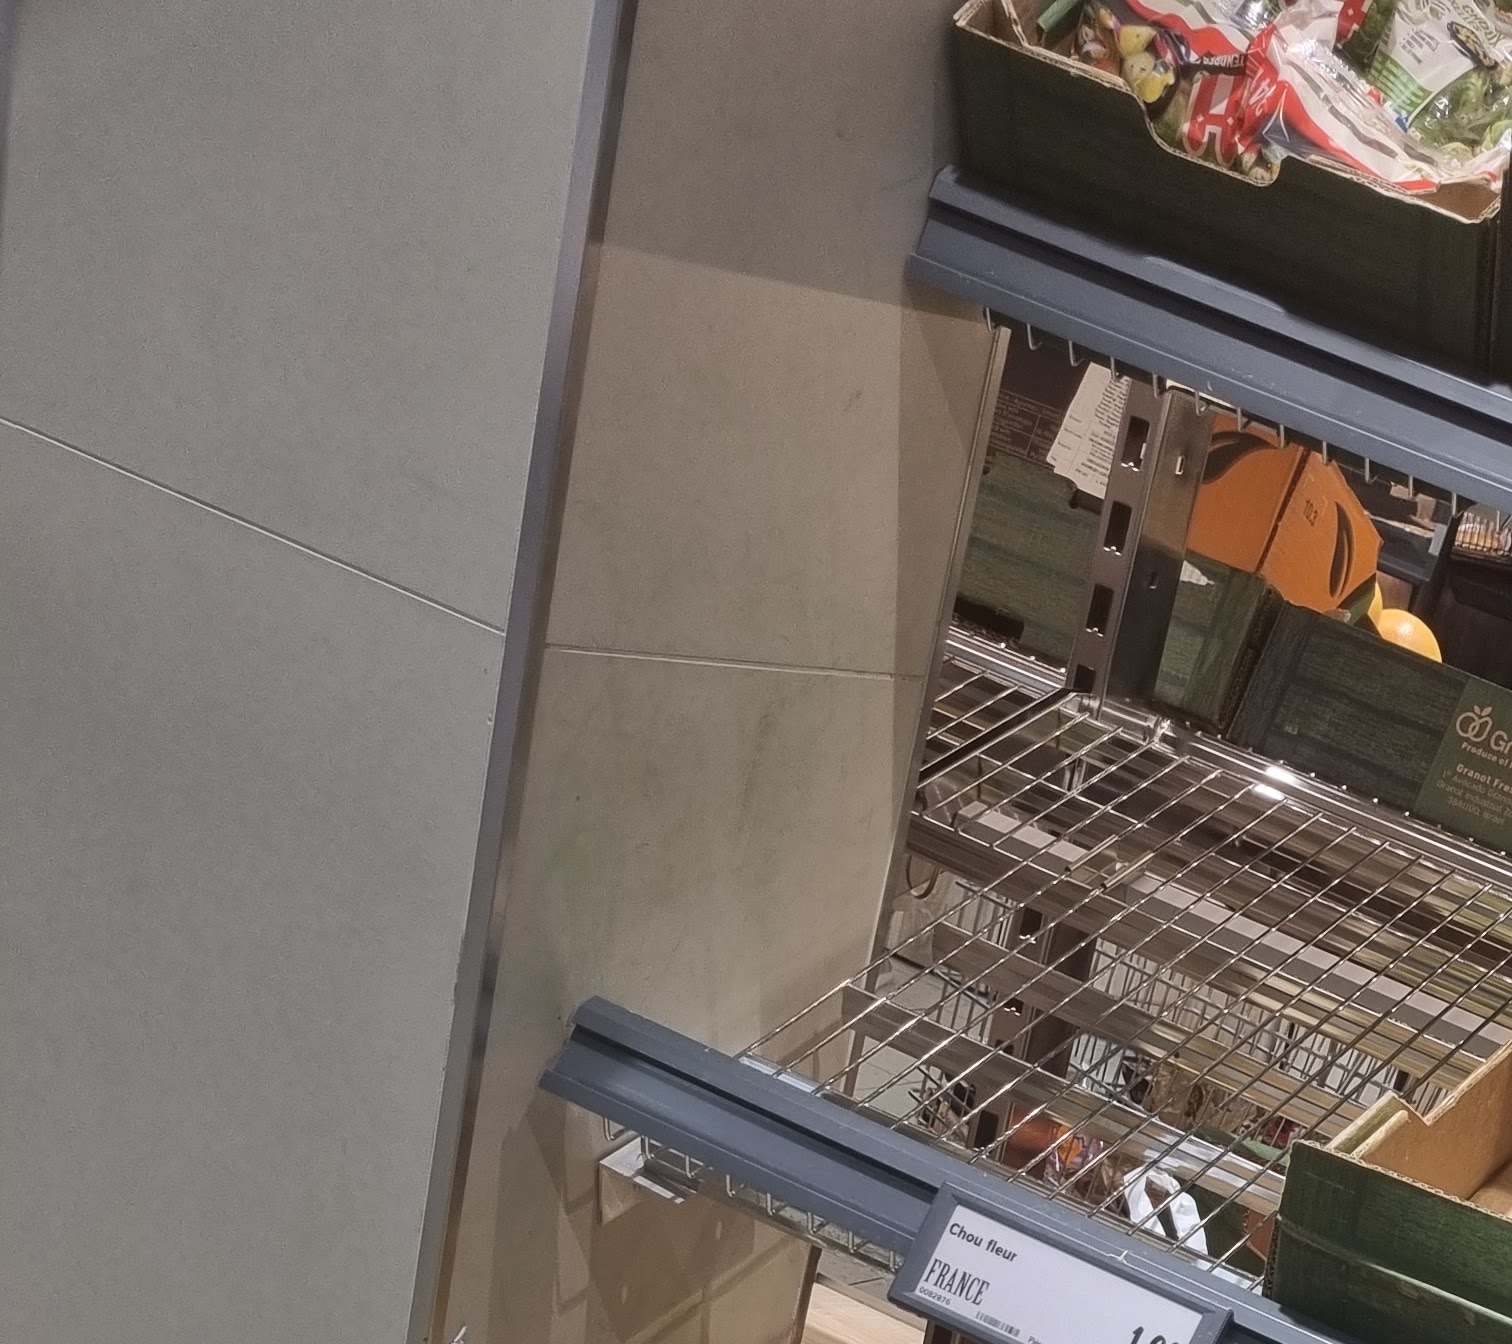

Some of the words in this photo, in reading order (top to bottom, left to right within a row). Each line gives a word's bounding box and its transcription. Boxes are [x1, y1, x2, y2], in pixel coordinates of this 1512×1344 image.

[1460, 741, 1498, 762] Produce
[1497, 756, 1509, 766] of
[1456, 763, 1491, 783] Granot
[947, 1221, 985, 1248] Chou
[984, 1237, 1019, 1263] fleur
[923, 1257, 990, 1307] FRANCE
